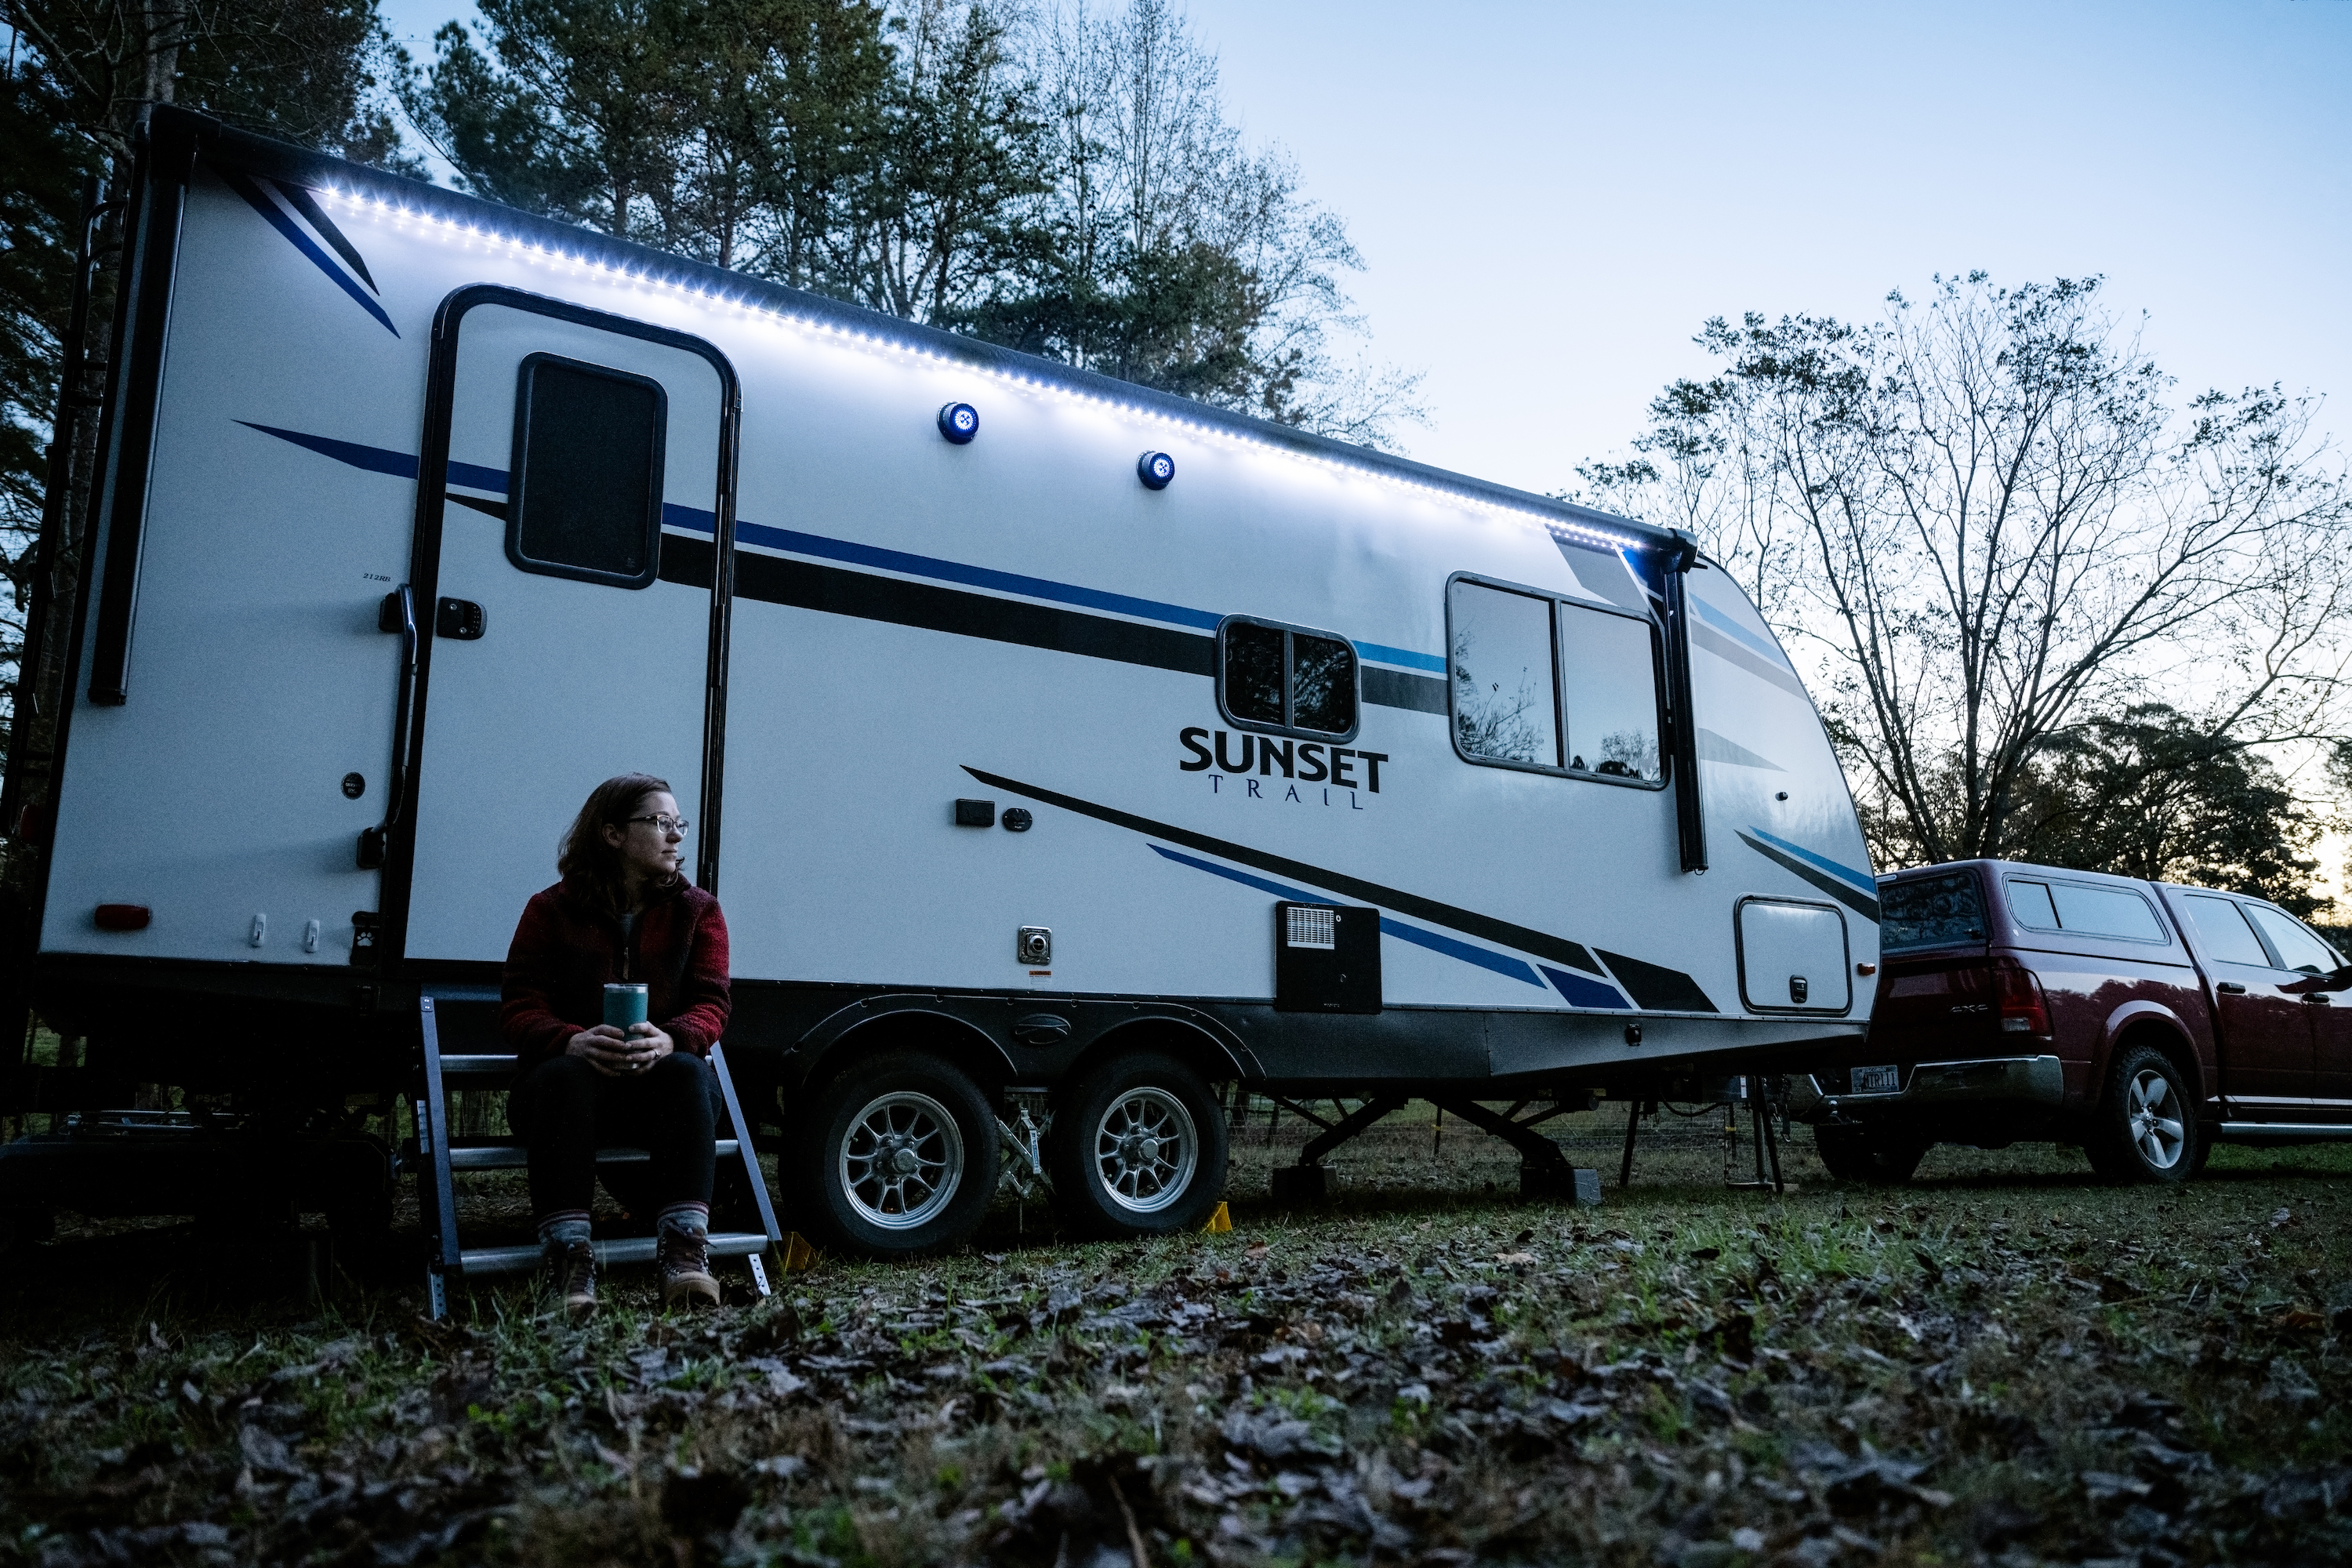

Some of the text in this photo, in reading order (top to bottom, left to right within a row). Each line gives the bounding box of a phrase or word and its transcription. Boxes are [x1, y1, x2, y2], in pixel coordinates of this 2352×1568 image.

[363, 572, 391, 582] 212RB
[1179, 727, 1388, 793] SUNSET
[1208, 774, 1363, 810] TRAIL
